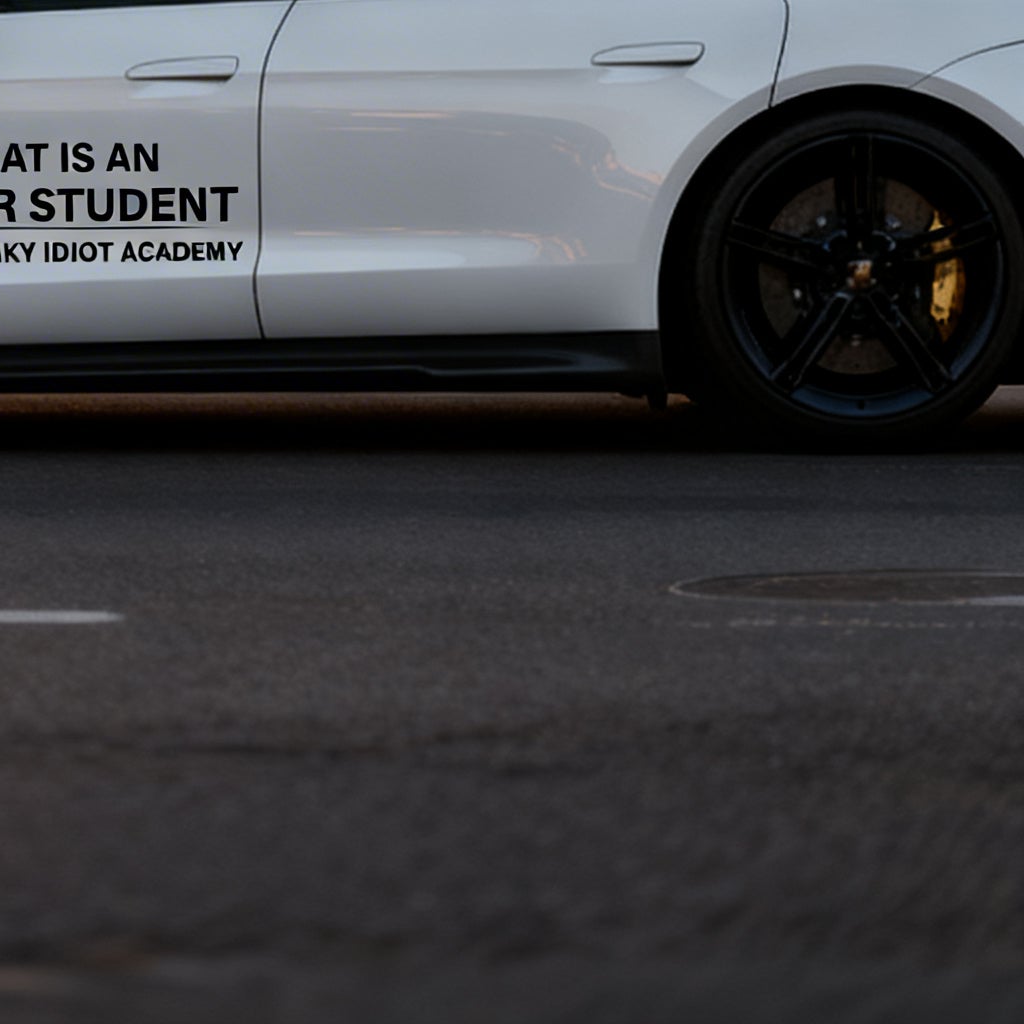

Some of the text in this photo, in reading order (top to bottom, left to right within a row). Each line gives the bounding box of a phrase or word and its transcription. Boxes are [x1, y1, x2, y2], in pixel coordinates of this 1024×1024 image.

[60, 142, 95, 173] IS
[105, 142, 159, 173] AN
[29, 186, 239, 223] STUDENT
[44, 241, 115, 263] IDIOT
[120, 240, 244, 263] ACADEMY
